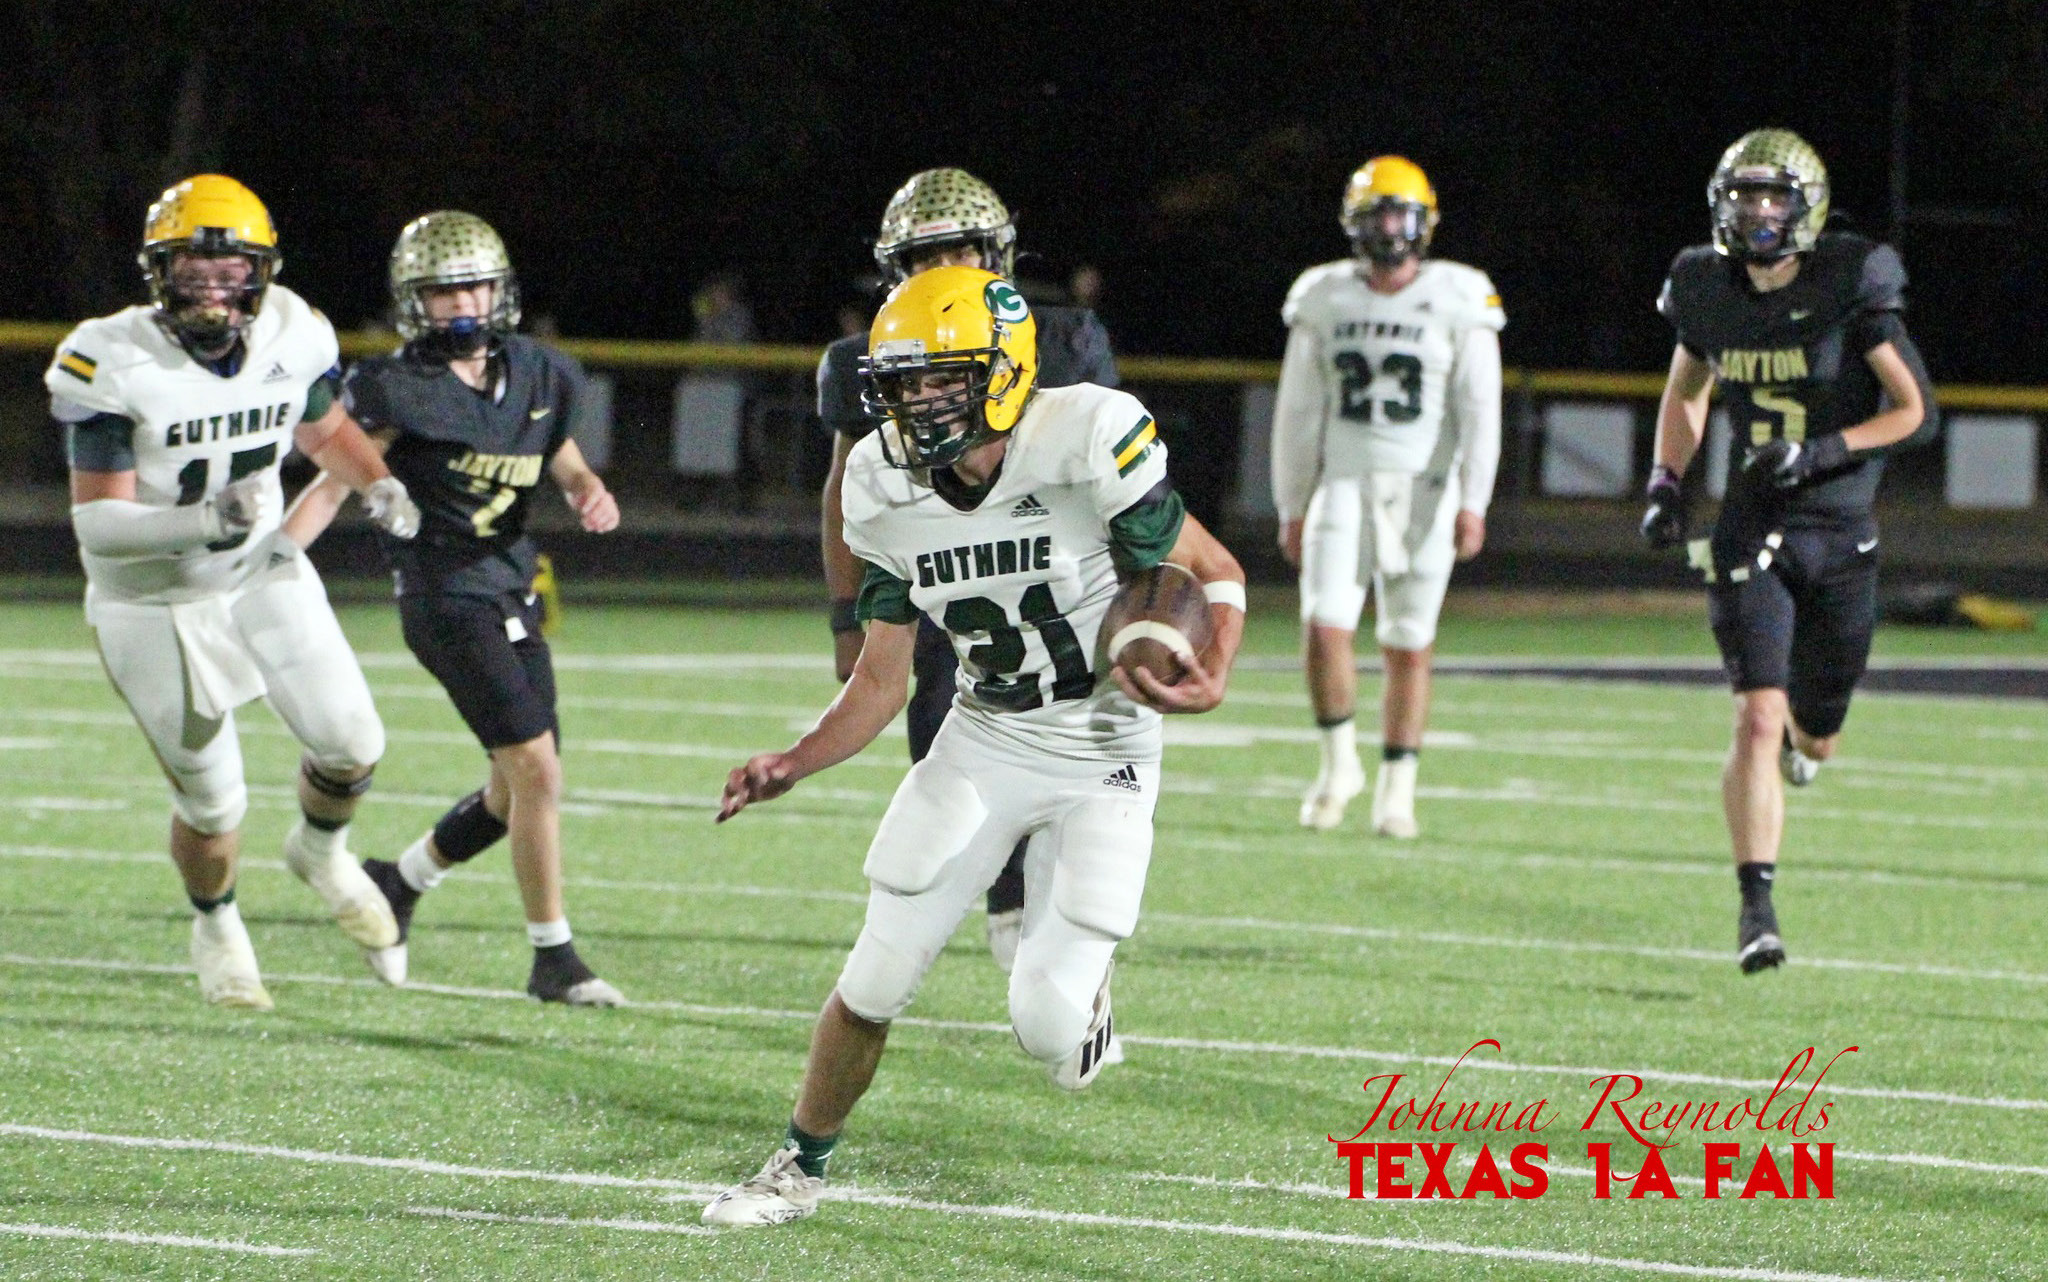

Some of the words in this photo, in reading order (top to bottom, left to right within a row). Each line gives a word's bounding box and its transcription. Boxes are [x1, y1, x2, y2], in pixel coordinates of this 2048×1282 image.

[1334, 351, 1422, 424] 23
[1717, 349, 1807, 382] JAYTON
[166, 402, 290, 447] GUTHRIE
[1751, 388, 1806, 447] 5
[1010, 508, 1050, 518] adidas
[916, 536, 1051, 588] GUTHRIE
[943, 582, 1096, 712] 21
[1103, 778, 1142, 792] adidas
